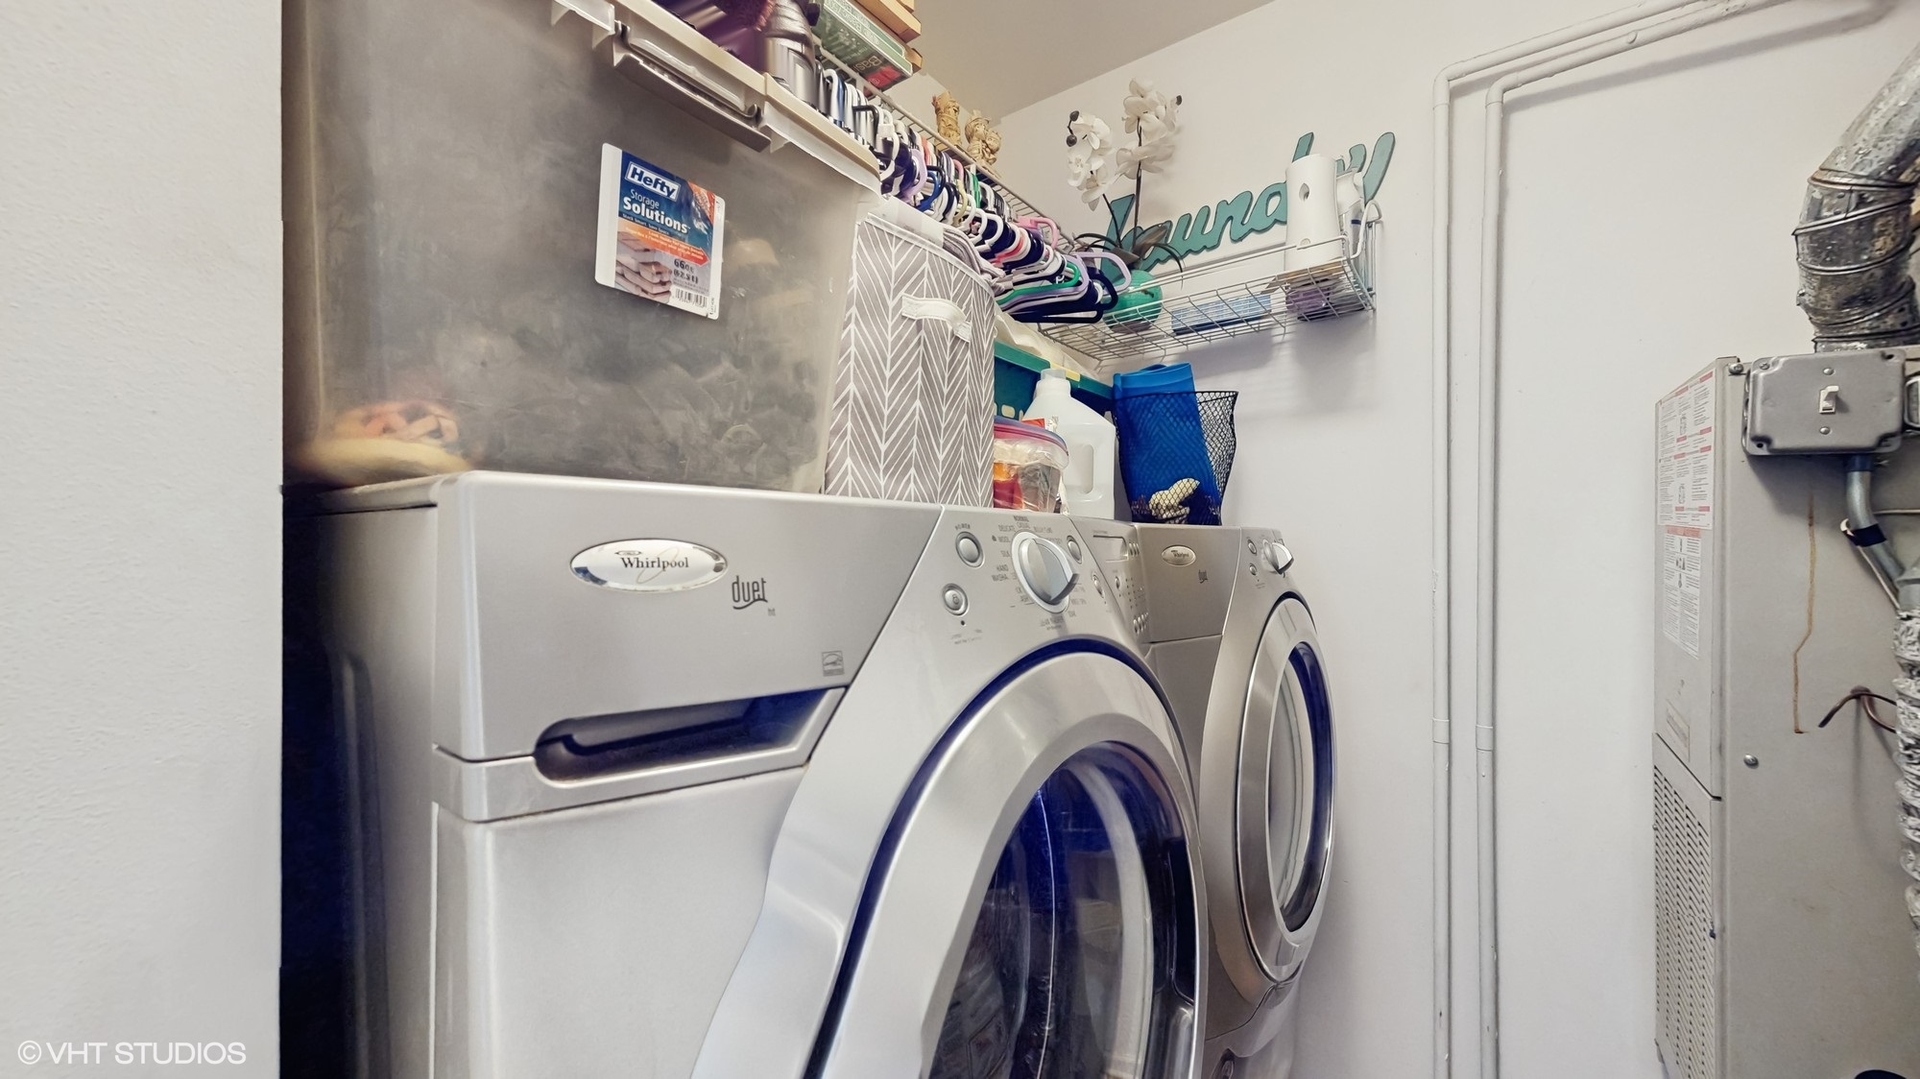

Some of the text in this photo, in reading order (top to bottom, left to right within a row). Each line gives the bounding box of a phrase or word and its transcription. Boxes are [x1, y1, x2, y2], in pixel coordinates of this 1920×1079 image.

[630, 167, 677, 199] Hefty
[630, 188, 660, 210] Storage
[623, 197, 688, 234] Solutions
[620, 557, 689, 572] Whirlpool
[731, 575, 767, 603] duet
